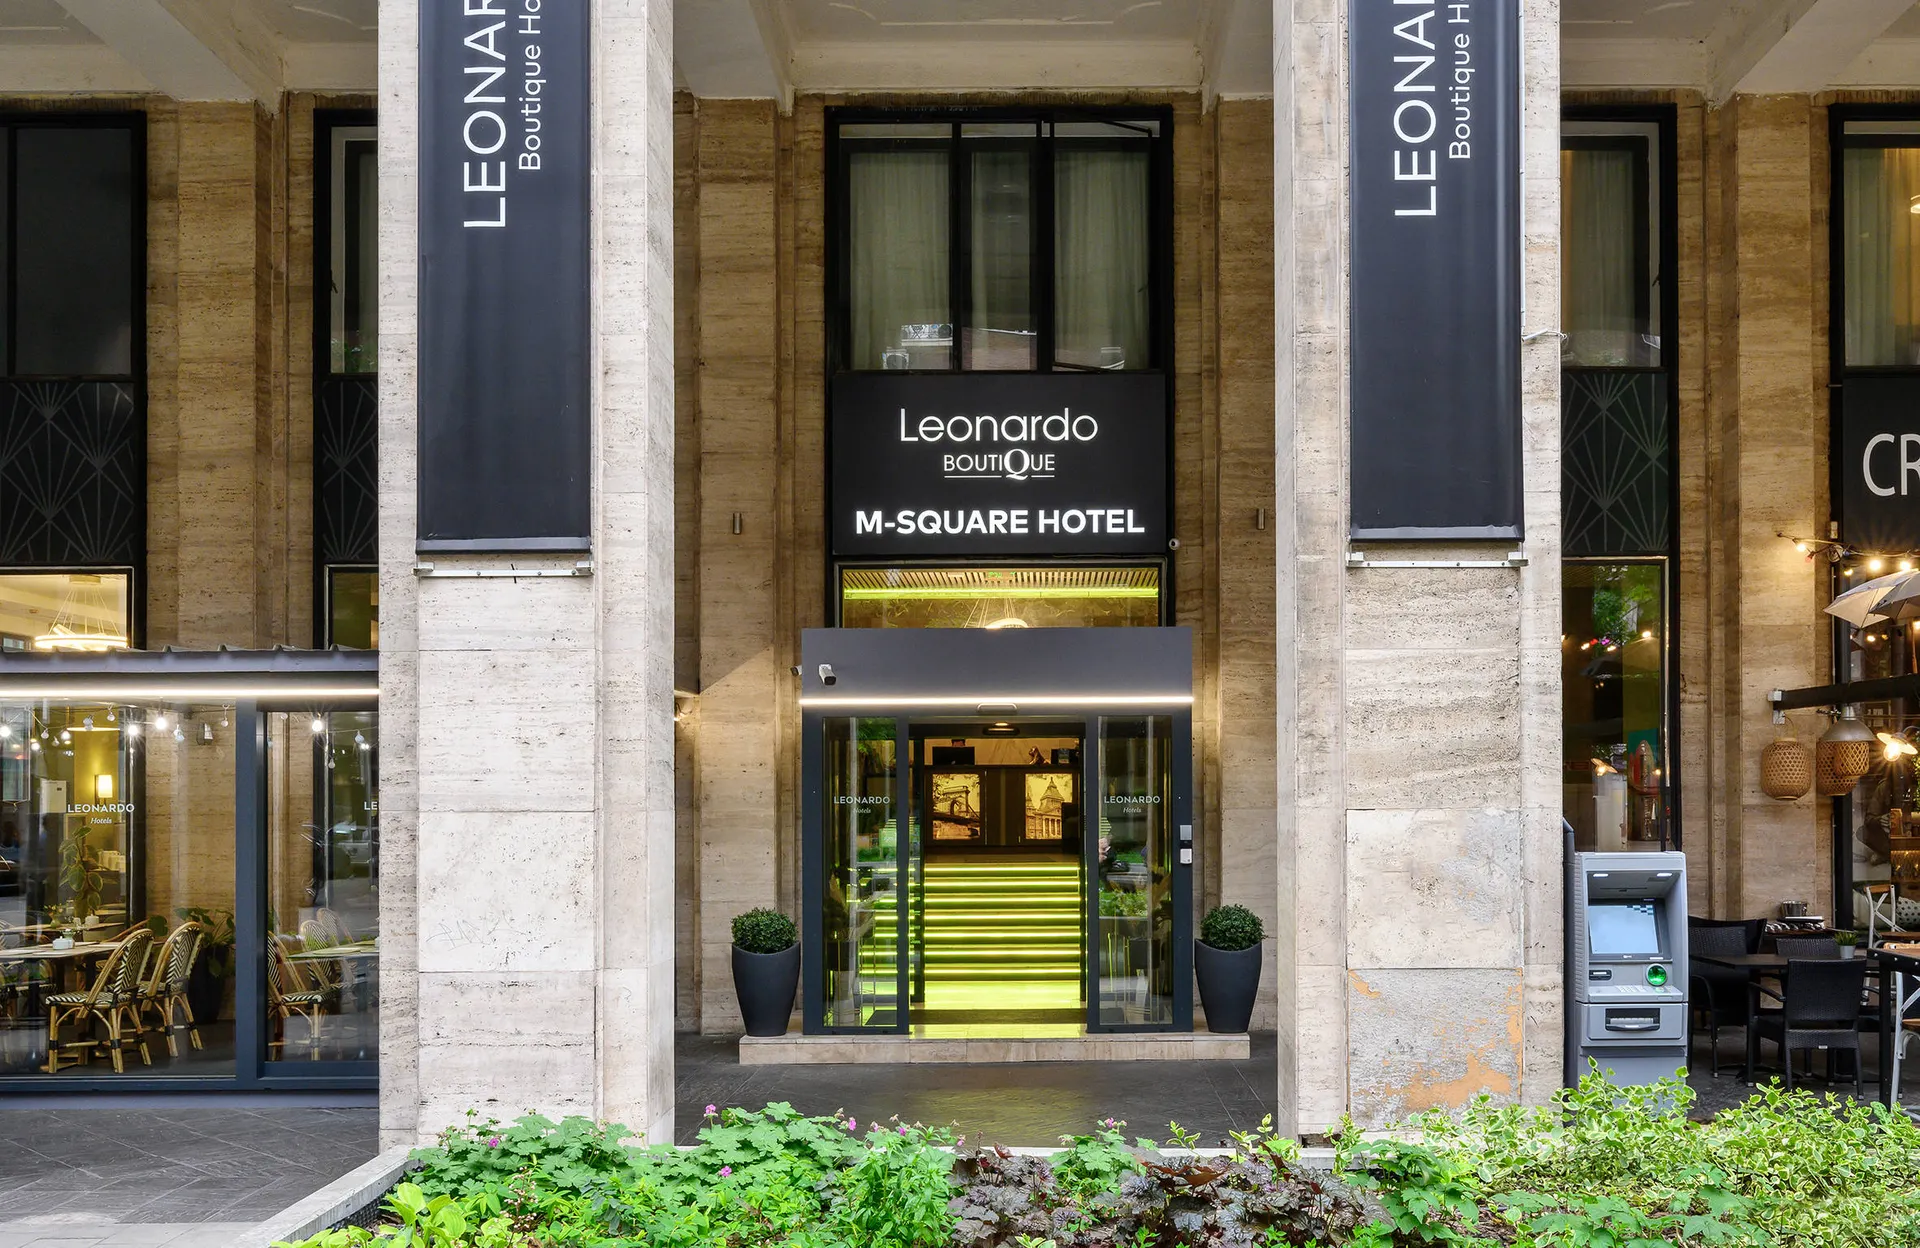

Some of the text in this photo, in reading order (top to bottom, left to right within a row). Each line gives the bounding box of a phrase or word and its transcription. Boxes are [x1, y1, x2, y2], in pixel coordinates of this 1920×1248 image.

[518, 44, 547, 171] Boutique
[1393, 0, 1436, 215] LEONA
[1448, 33, 1476, 160] Boutique
[900, 407, 1099, 442] Leonardo
[943, 448, 1056, 481] BOUTIQUE
[855, 509, 1146, 535] M-SQUARE HOTEL
[67, 803, 135, 813] LEONARDO
[833, 796, 891, 804] LEONARDO
[1104, 795, 1161, 804] LEONARDO
